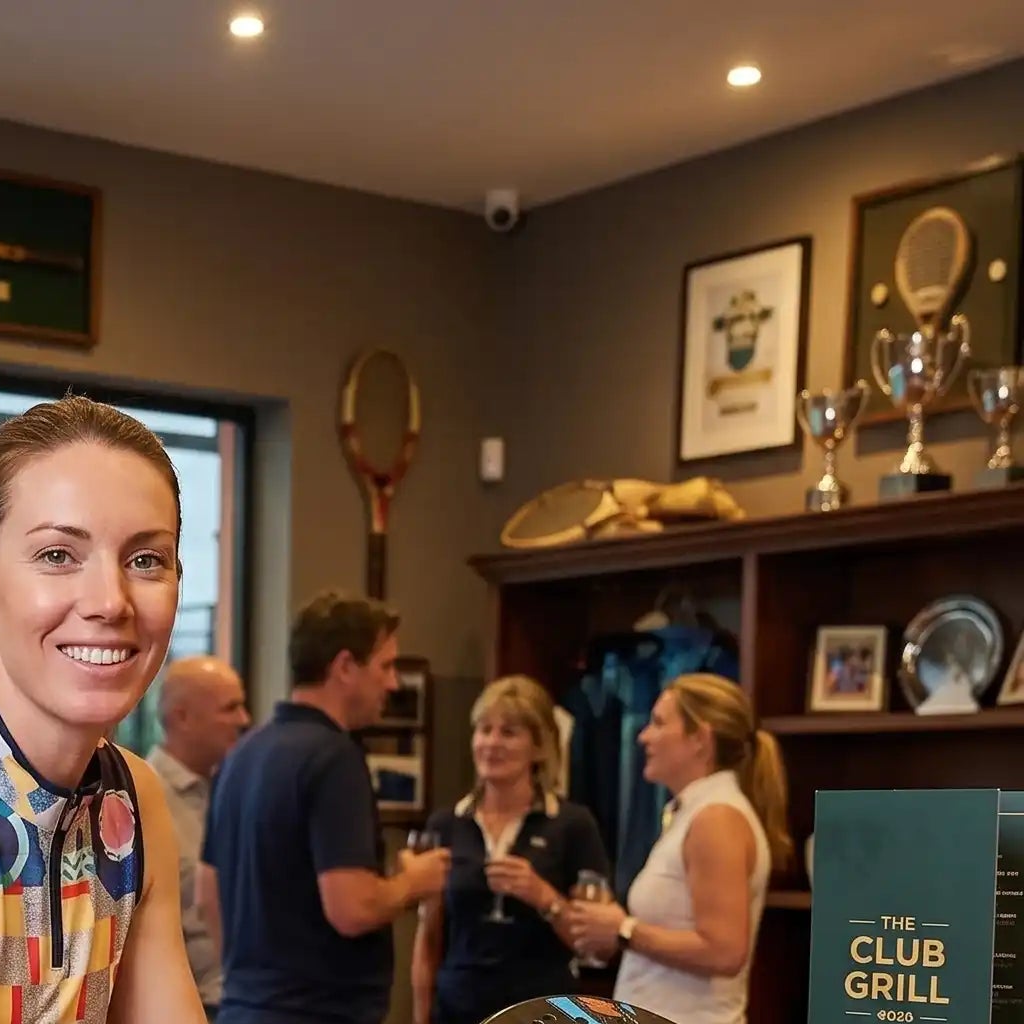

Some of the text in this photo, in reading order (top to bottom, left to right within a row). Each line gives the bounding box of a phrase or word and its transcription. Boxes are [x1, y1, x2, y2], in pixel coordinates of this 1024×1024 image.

[880, 915, 916, 931] THE
[850, 935, 946, 968] CLUB
[844, 970, 950, 1005] GRILL
